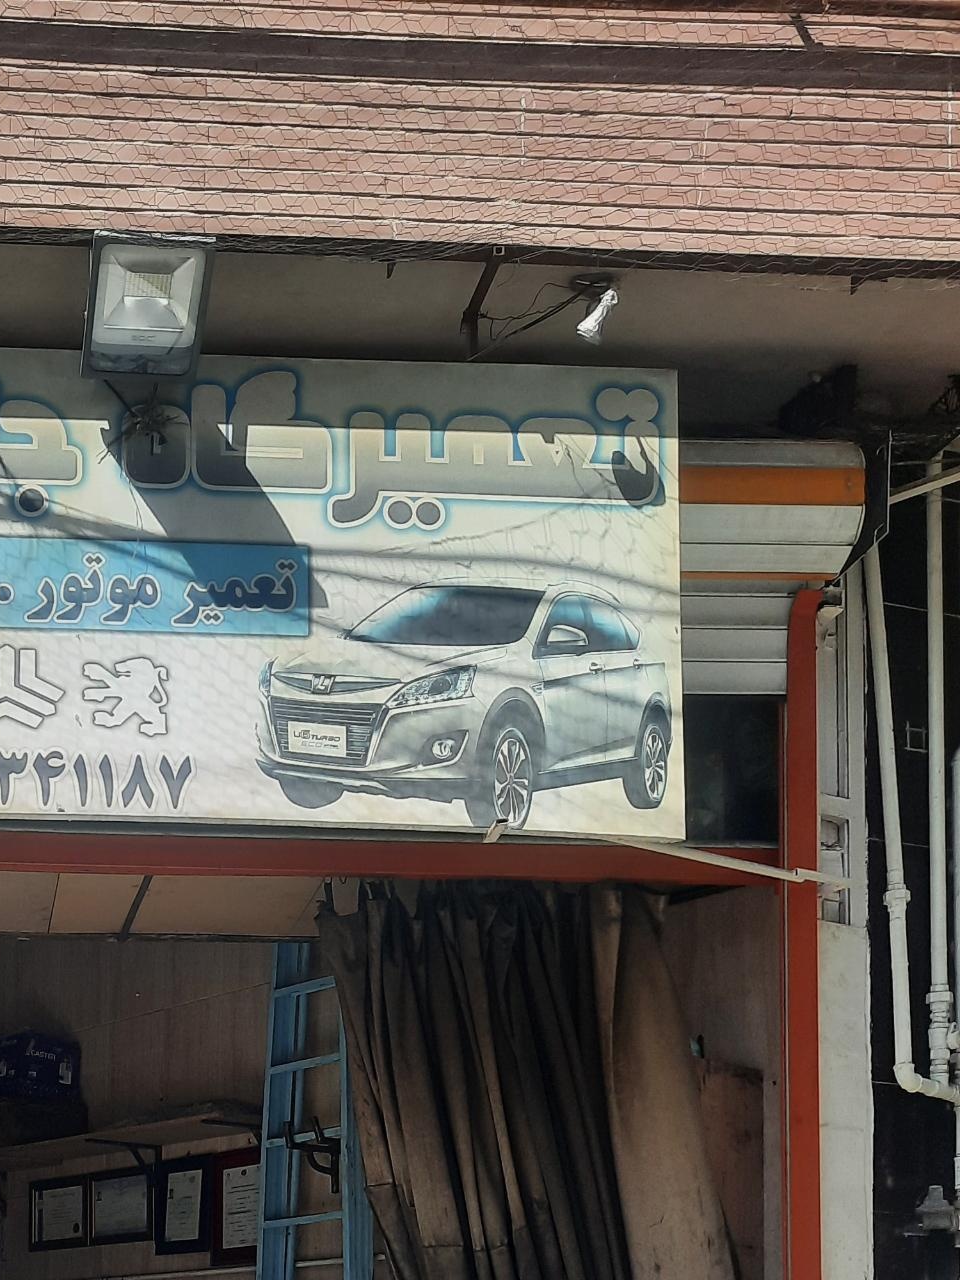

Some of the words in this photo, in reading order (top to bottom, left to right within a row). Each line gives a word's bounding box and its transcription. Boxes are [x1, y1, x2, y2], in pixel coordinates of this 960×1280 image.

[122, 371, 663, 528] تعمیرگاه
[25, 551, 162, 623] موتور
[171, 557, 298, 626] تعمیر
